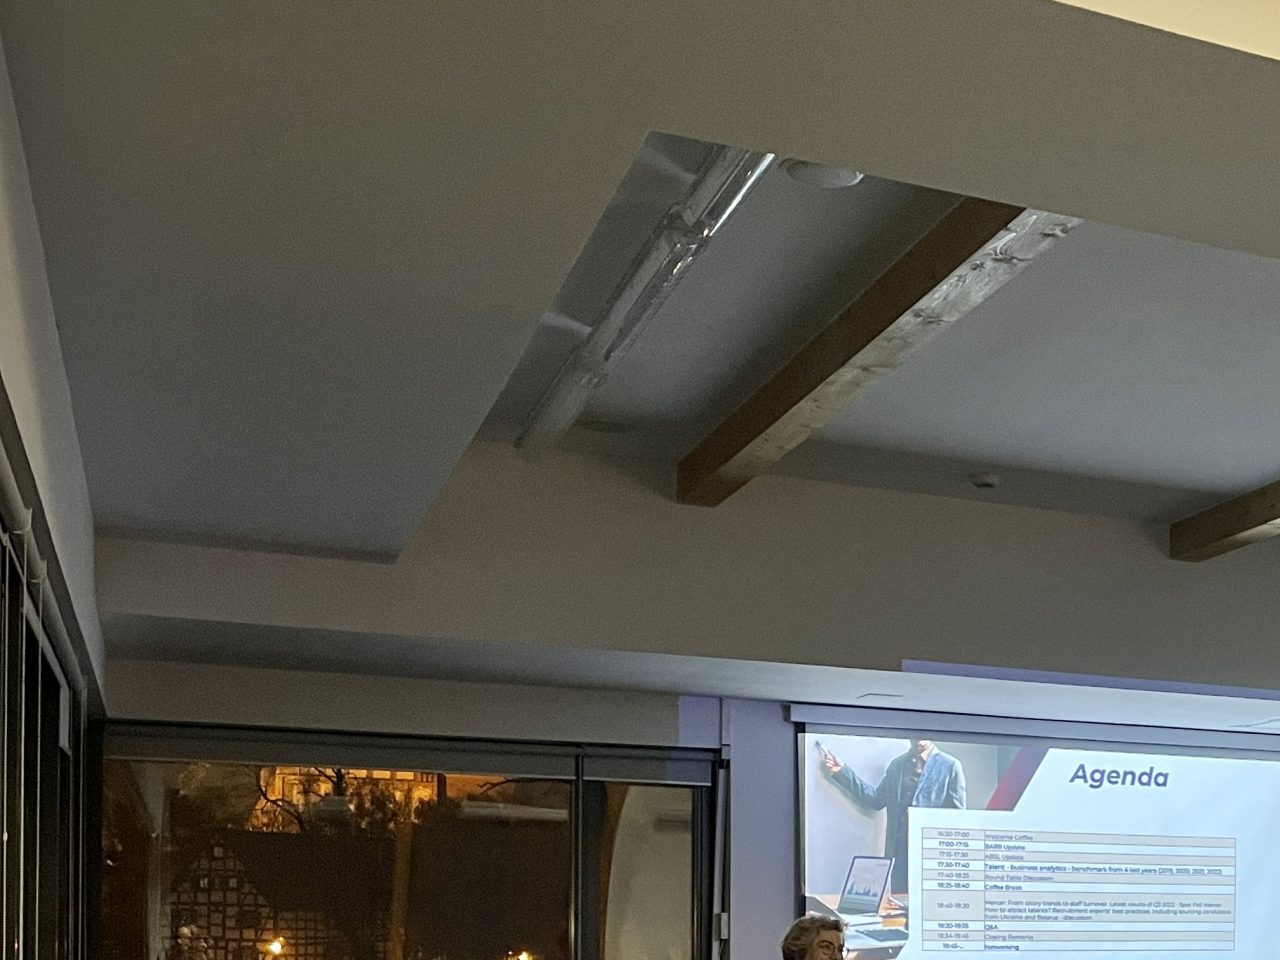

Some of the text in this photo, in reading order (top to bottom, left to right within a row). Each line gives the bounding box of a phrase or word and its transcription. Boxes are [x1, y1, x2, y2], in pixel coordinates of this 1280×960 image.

[1069, 763, 1170, 789] Agenda
[1003, 844, 1026, 852] Update
[1039, 865, 1067, 873] analytics
[1071, 865, 1107, 873] benchmark
